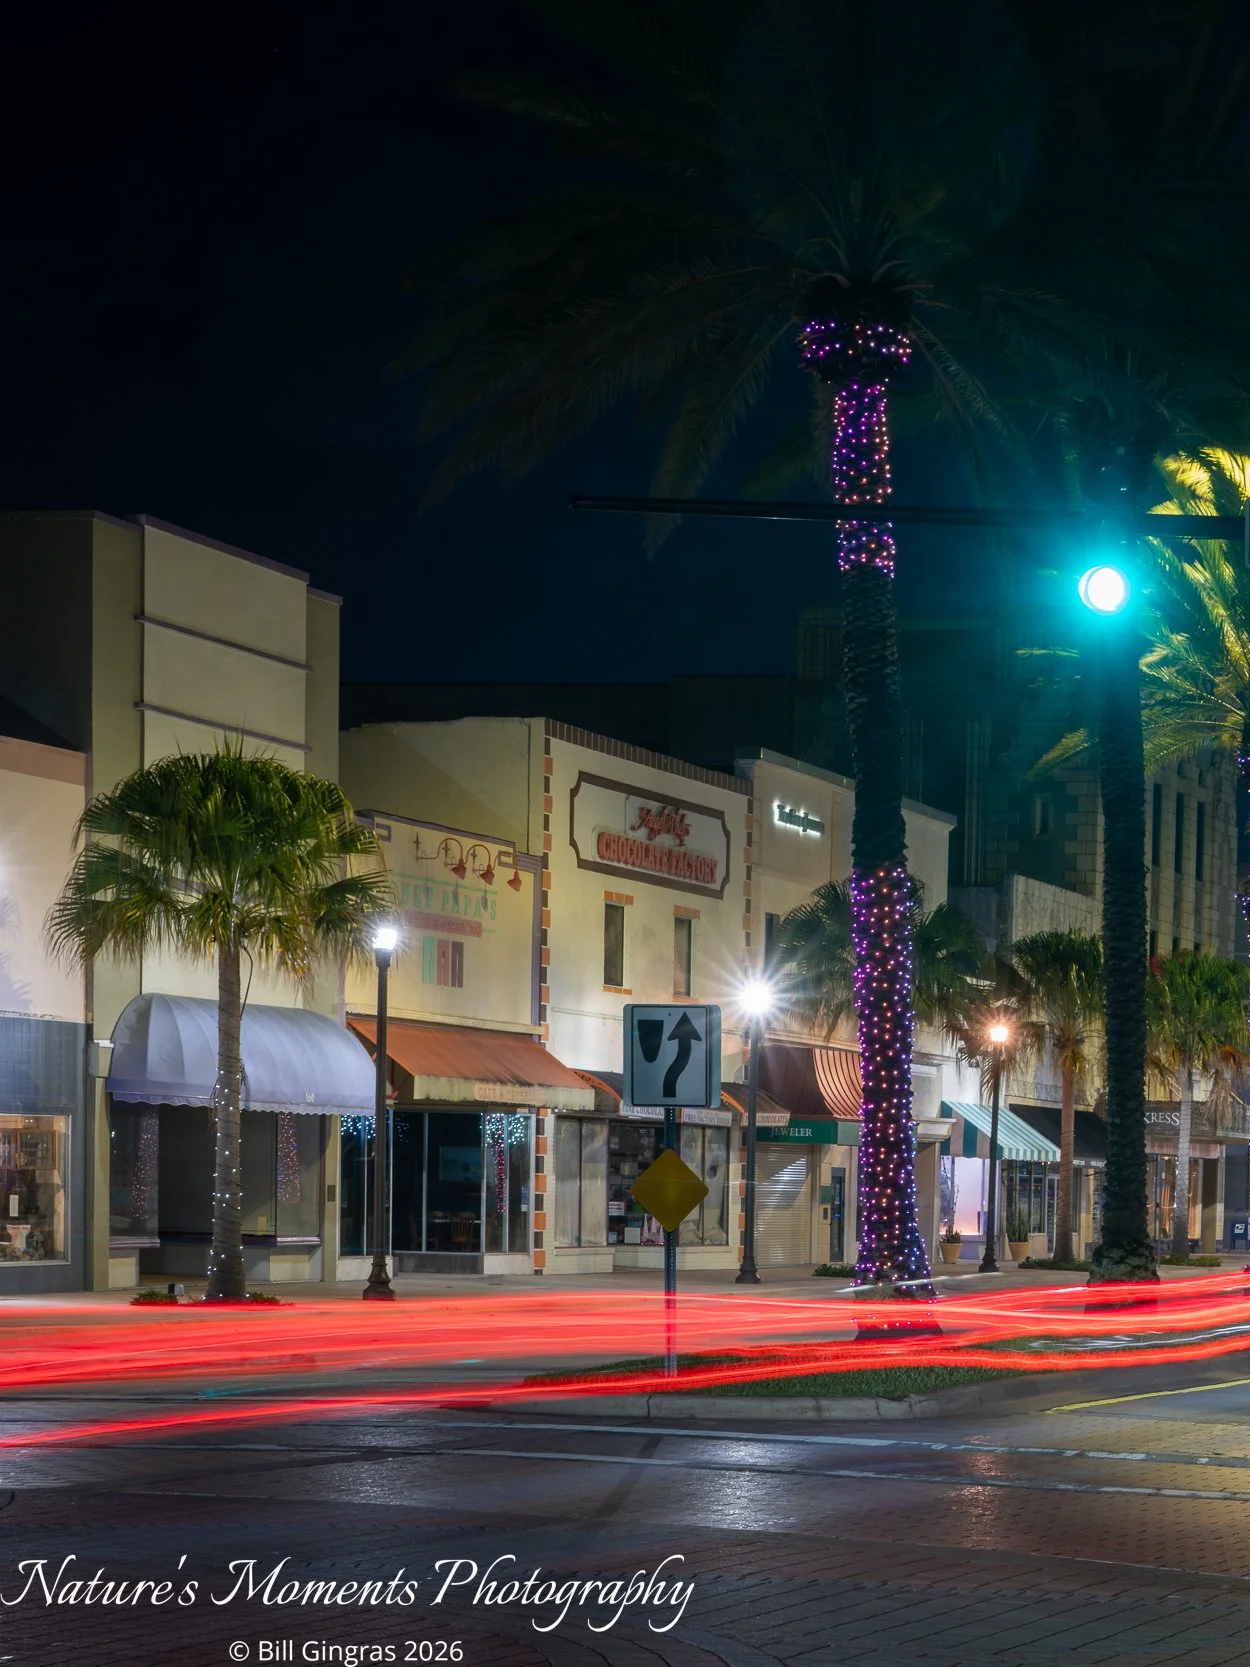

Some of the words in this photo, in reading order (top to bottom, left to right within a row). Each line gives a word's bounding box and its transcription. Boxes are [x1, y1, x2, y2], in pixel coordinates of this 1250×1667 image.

[601, 832, 670, 871] CHOCOLATE
[671, 849, 718, 884] FACTORY
[757, 1114, 789, 1124] CHOCOLATES
[769, 1126, 813, 1138] JEWELER
